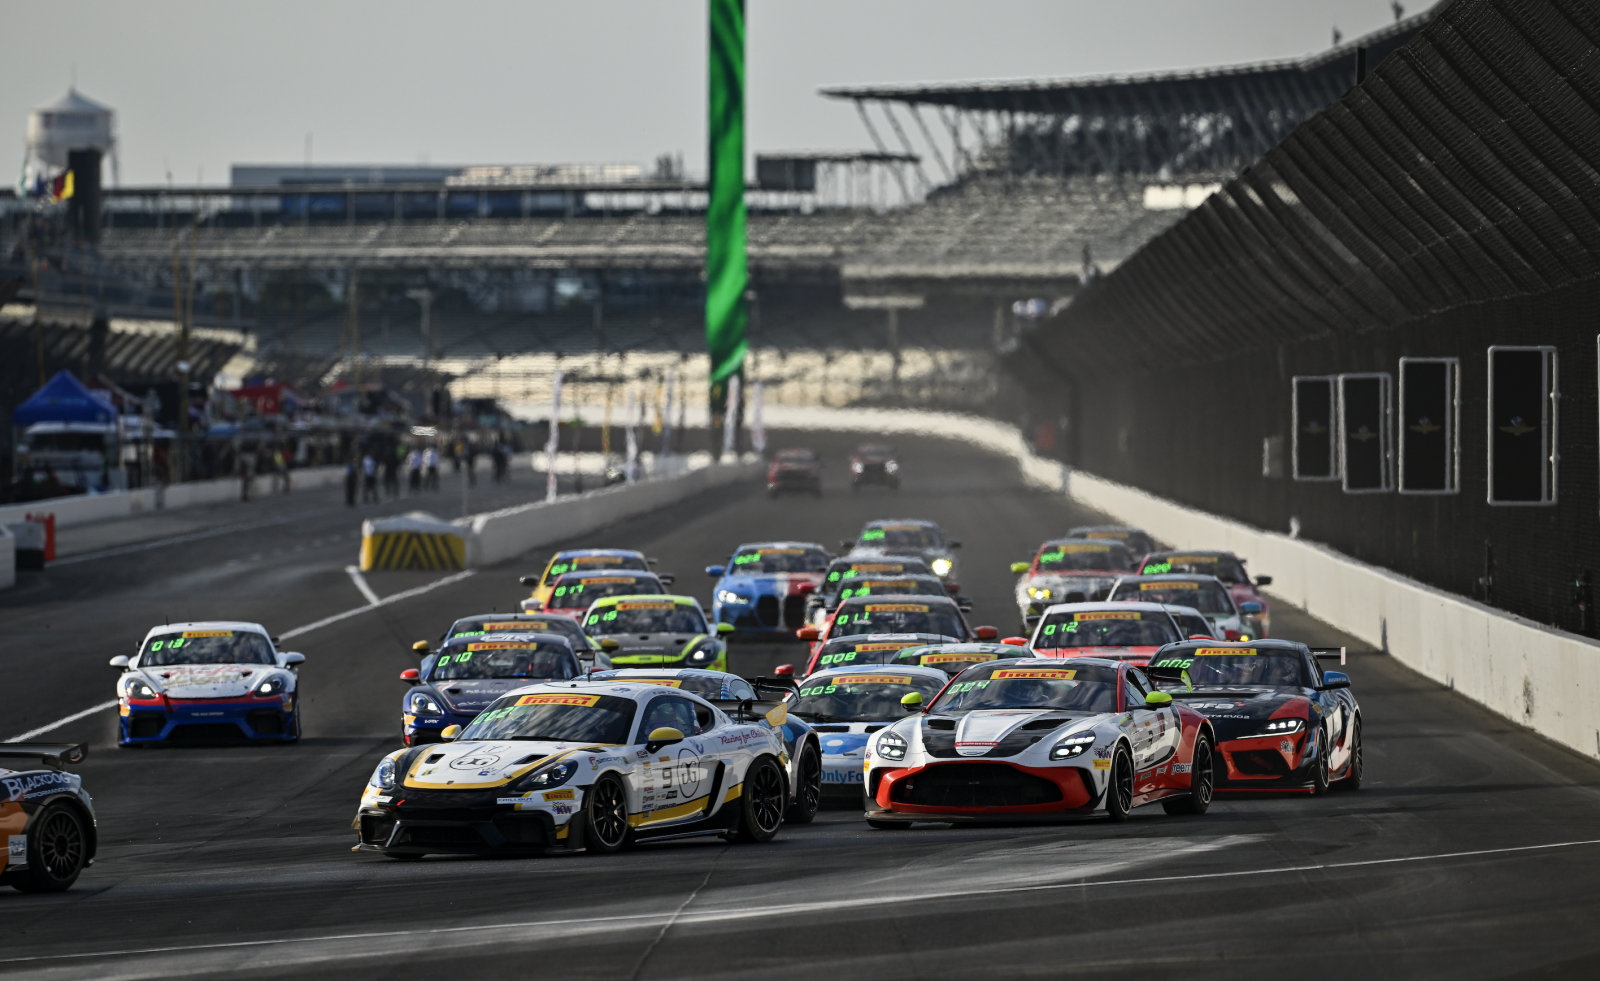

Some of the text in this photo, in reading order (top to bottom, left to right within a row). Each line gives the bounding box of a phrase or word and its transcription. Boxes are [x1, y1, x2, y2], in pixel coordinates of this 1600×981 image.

[490, 622, 542, 630] PIRELLI
[1044, 621, 1078, 636] 012
[151, 638, 185, 652] 013
[438, 652, 473, 667] 010
[820, 651, 857, 665] 008
[927, 655, 992, 663] PIRELLI
[838, 676, 906, 684] PIRELLI
[998, 670, 1069, 679] PIRELLI
[800, 684, 837, 697] 005
[947, 680, 991, 695] 004
[521, 696, 592, 706] PIRELLI
[718, 734, 742, 745] Racing
[662, 767, 672, 789] 9
[2, 773, 71, 802] BLACKDOG
[545, 791, 573, 800] PIRELLI
[556, 805, 572, 815] KW
